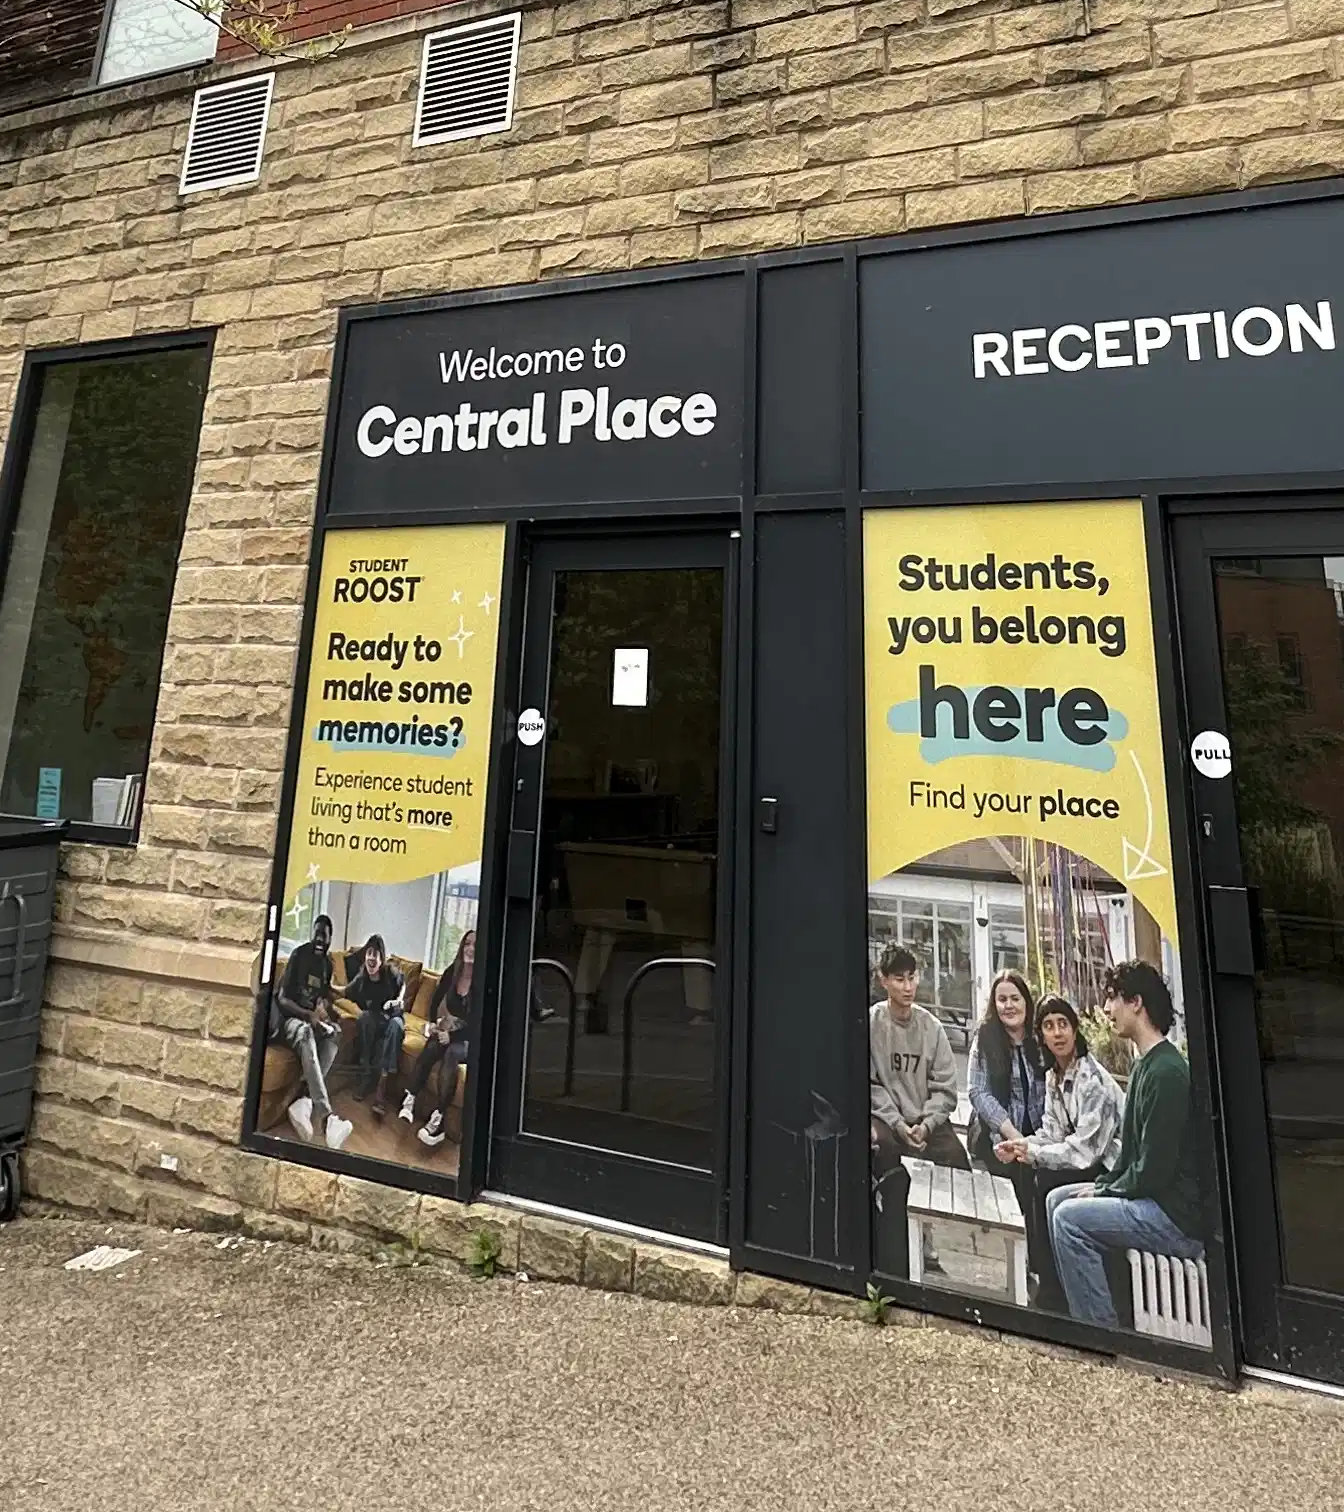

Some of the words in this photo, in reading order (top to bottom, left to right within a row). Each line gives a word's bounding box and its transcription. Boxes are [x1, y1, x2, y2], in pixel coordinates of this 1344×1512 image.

[972, 299, 1338, 379] RECEPTION
[439, 346, 585, 384] Welcome
[592, 338, 627, 369] to
[357, 392, 547, 458] Central
[558, 386, 718, 444] Place
[349, 559, 408, 573] STUDENT
[898, 553, 1110, 596] Students,
[333, 576, 421, 603] ROOST
[888, 616, 962, 655] you
[972, 606, 1127, 657] belong
[328, 632, 408, 670] Ready
[413, 635, 442, 662] to
[323, 673, 393, 702] make
[398, 680, 472, 704] some
[919, 664, 1110, 746] here
[318, 714, 464, 748] memories?
[518, 722, 543, 732] PUSH
[1195, 748, 1231, 760] PULL
[315, 767, 403, 793] Experience
[406, 775, 473, 796] student
[311, 796, 352, 824] living
[356, 800, 404, 822] that's
[407, 808, 453, 826] more
[910, 781, 965, 810] Find
[973, 792, 1032, 818] your
[1039, 789, 1120, 822] place
[308, 827, 345, 848] than
[349, 835, 360, 850] a
[364, 837, 407, 854] room
[890, 1051, 921, 1074] 1977
